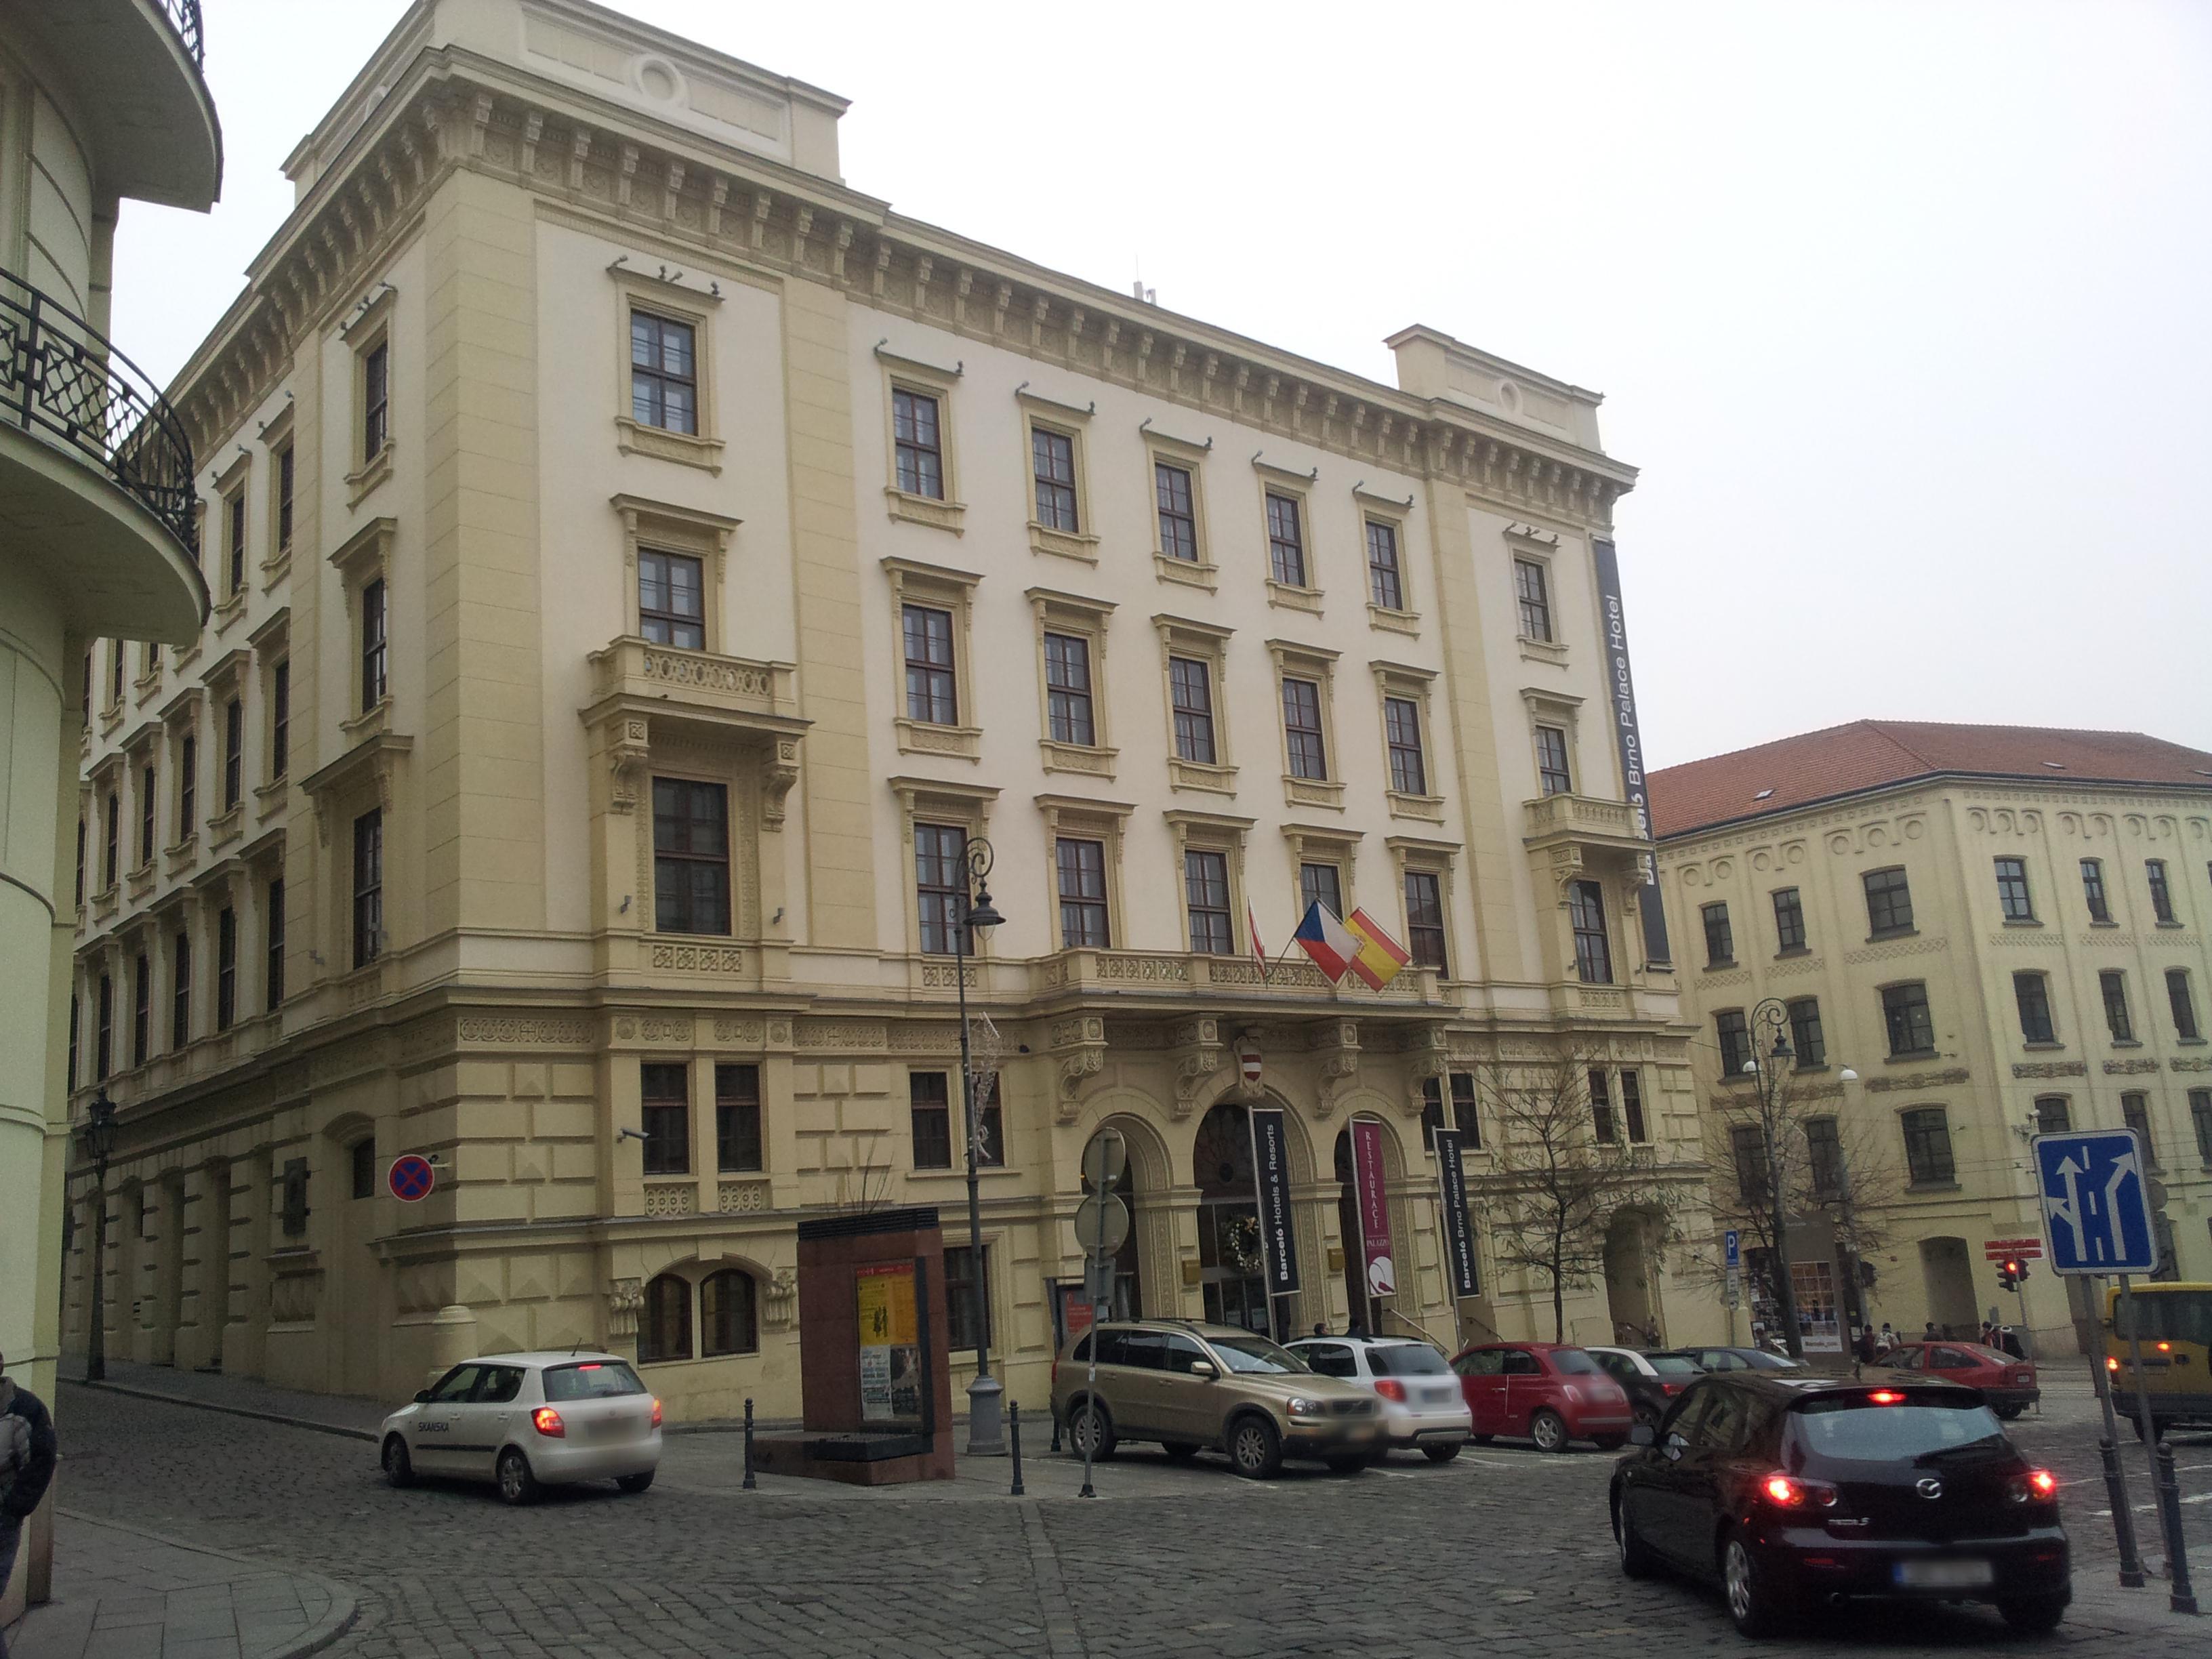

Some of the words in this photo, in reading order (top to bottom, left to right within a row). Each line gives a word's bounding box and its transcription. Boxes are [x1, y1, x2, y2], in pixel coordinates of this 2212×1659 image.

[1605, 594, 1625, 649] Hotel
[1616, 657, 1634, 727] Palace
[1626, 735, 1641, 786] Brno
[1267, 1124, 1277, 1170] Resorts
[1446, 1139, 1455, 1168] Hotel
[1270, 1174, 1279, 1183] &
[1366, 1131, 1379, 1229] RESTAURACE
[1452, 1171, 1461, 1208] Palace
[1272, 1187, 1282, 1225] Hotels
[1456, 1211, 1465, 1237] Brno
[1275, 1228, 1288, 1281] Barceló
[1459, 1241, 1471, 1288] Barceló
[1727, 1235, 1736, 1256] P
[418, 1422, 449, 1432] SKANSKA
